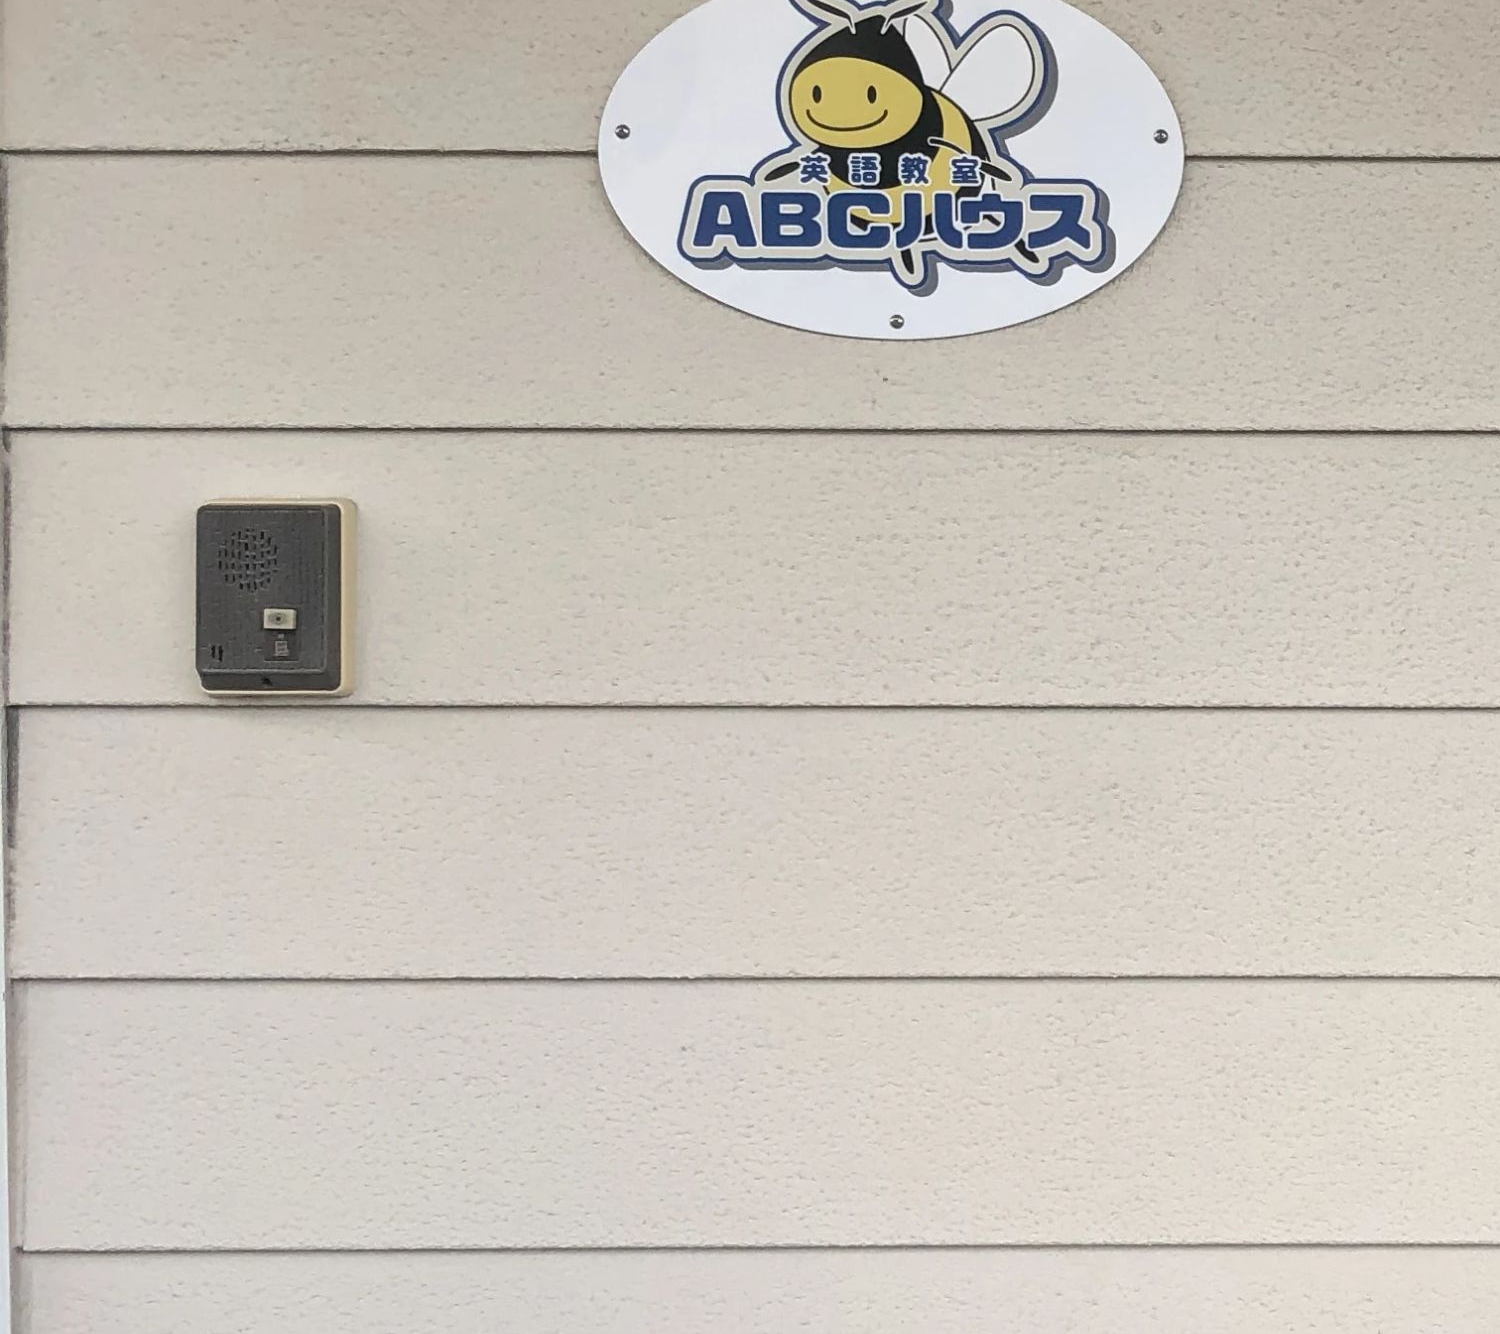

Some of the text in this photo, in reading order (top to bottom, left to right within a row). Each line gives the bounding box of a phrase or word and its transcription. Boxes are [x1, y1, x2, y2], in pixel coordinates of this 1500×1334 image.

[799, 154, 980, 185] 英語教室
[692, 190, 1092, 249] ABCハウス
